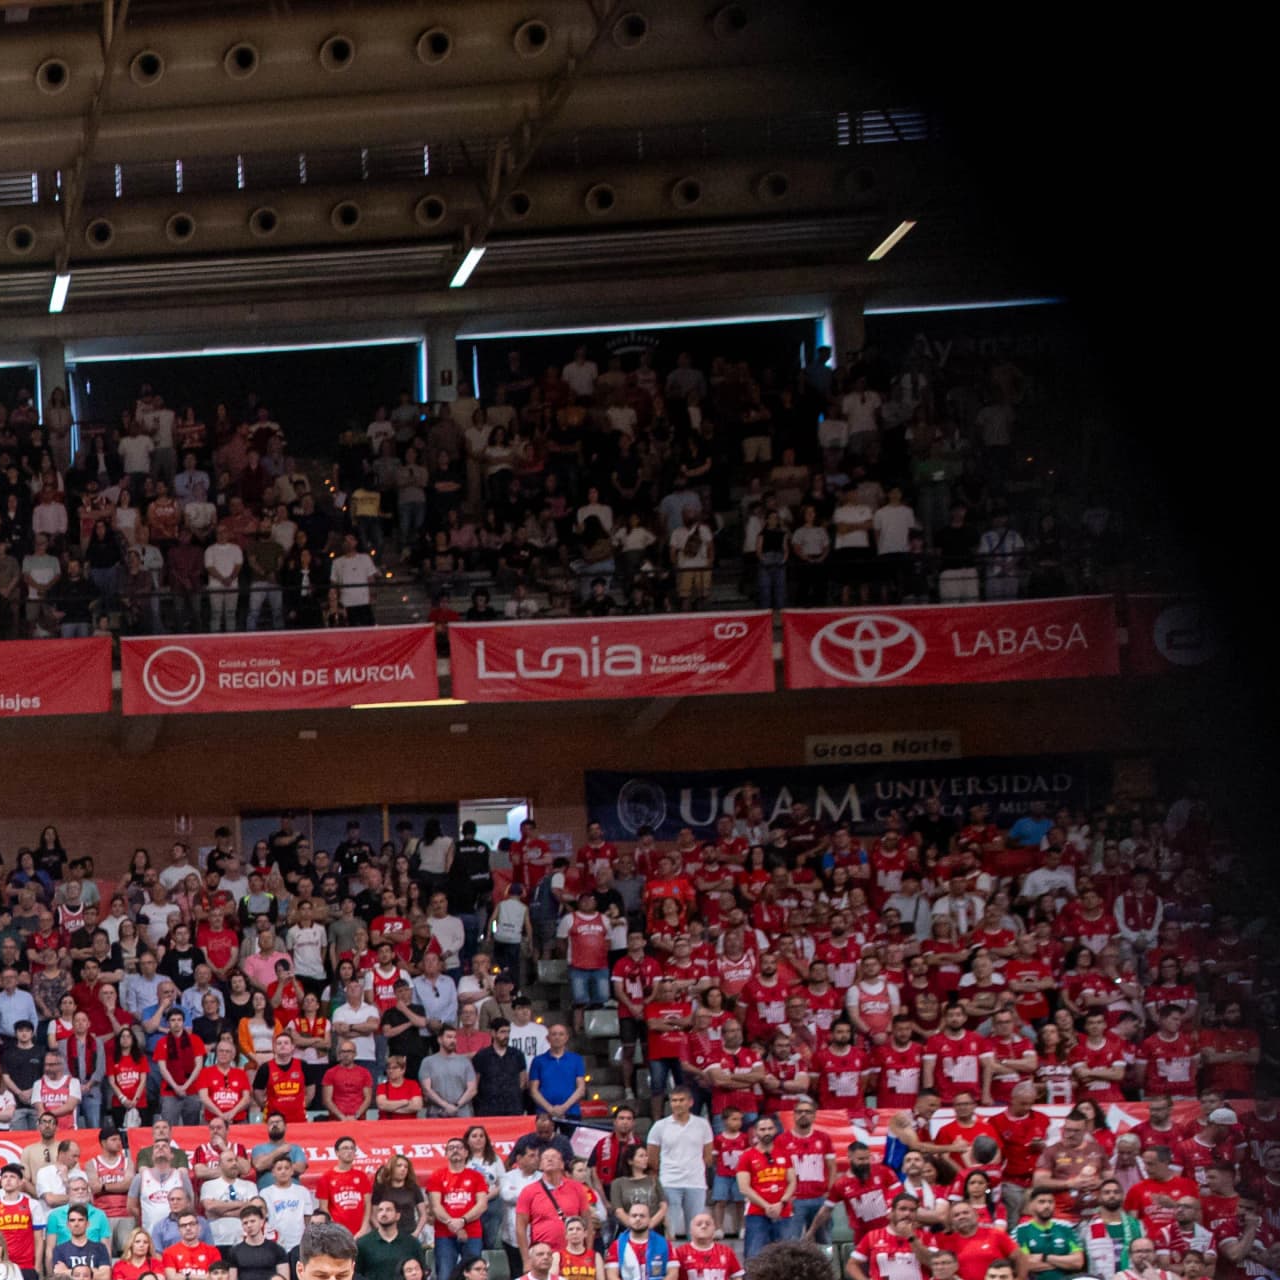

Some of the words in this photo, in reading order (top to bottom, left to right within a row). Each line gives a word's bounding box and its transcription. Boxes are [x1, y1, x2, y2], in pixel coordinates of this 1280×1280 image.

[951, 624, 1089, 658] LABASA
[218, 668, 297, 689] REGIÓN
[301, 668, 328, 686] DE
[334, 663, 416, 684] MURCIA
[873, 773, 1072, 800] UNIVERSIDAD
